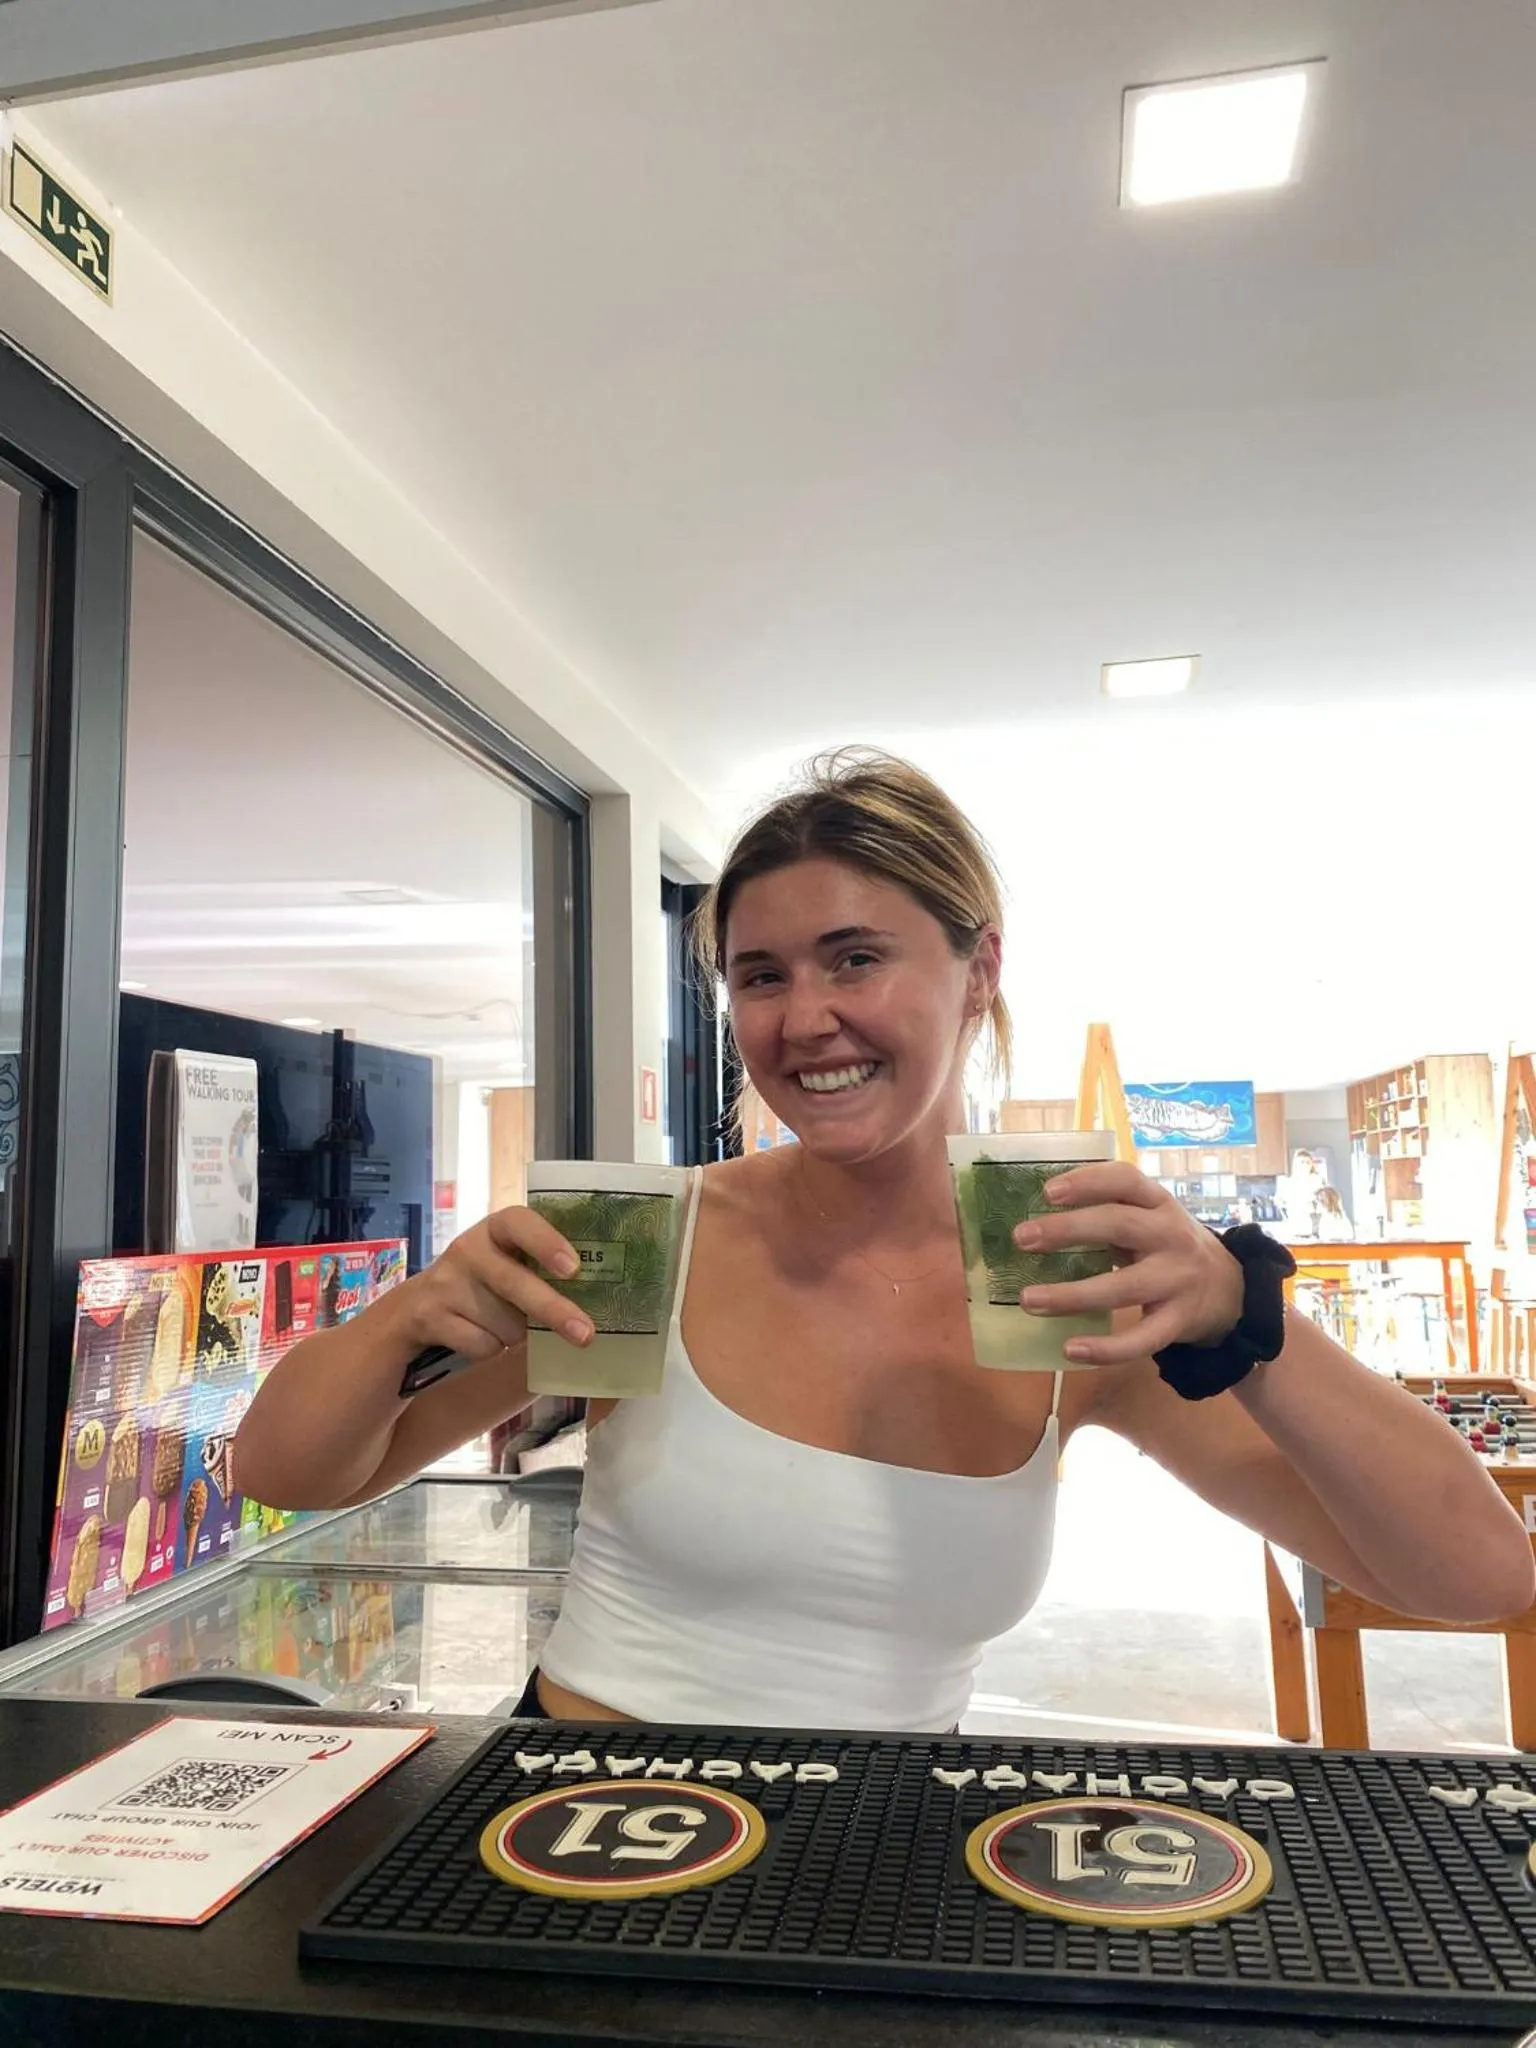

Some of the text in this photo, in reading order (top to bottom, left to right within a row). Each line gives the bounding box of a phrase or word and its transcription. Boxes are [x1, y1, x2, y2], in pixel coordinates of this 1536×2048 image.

[185, 1067, 219, 1086] FREE
[187, 1084, 230, 1102] WALKING
[216, 1729, 341, 1744] SCAN ME!
[49, 1812, 262, 1831] JOIN OUR GROUP CHAT
[81, 1833, 176, 1845] ACTIVITIES
[548, 1801, 708, 1862] 51
[67, 1845, 110, 1856] OUR
[113, 1849, 211, 1861] DISCOVER
[1031, 1821, 1199, 1886] 51
